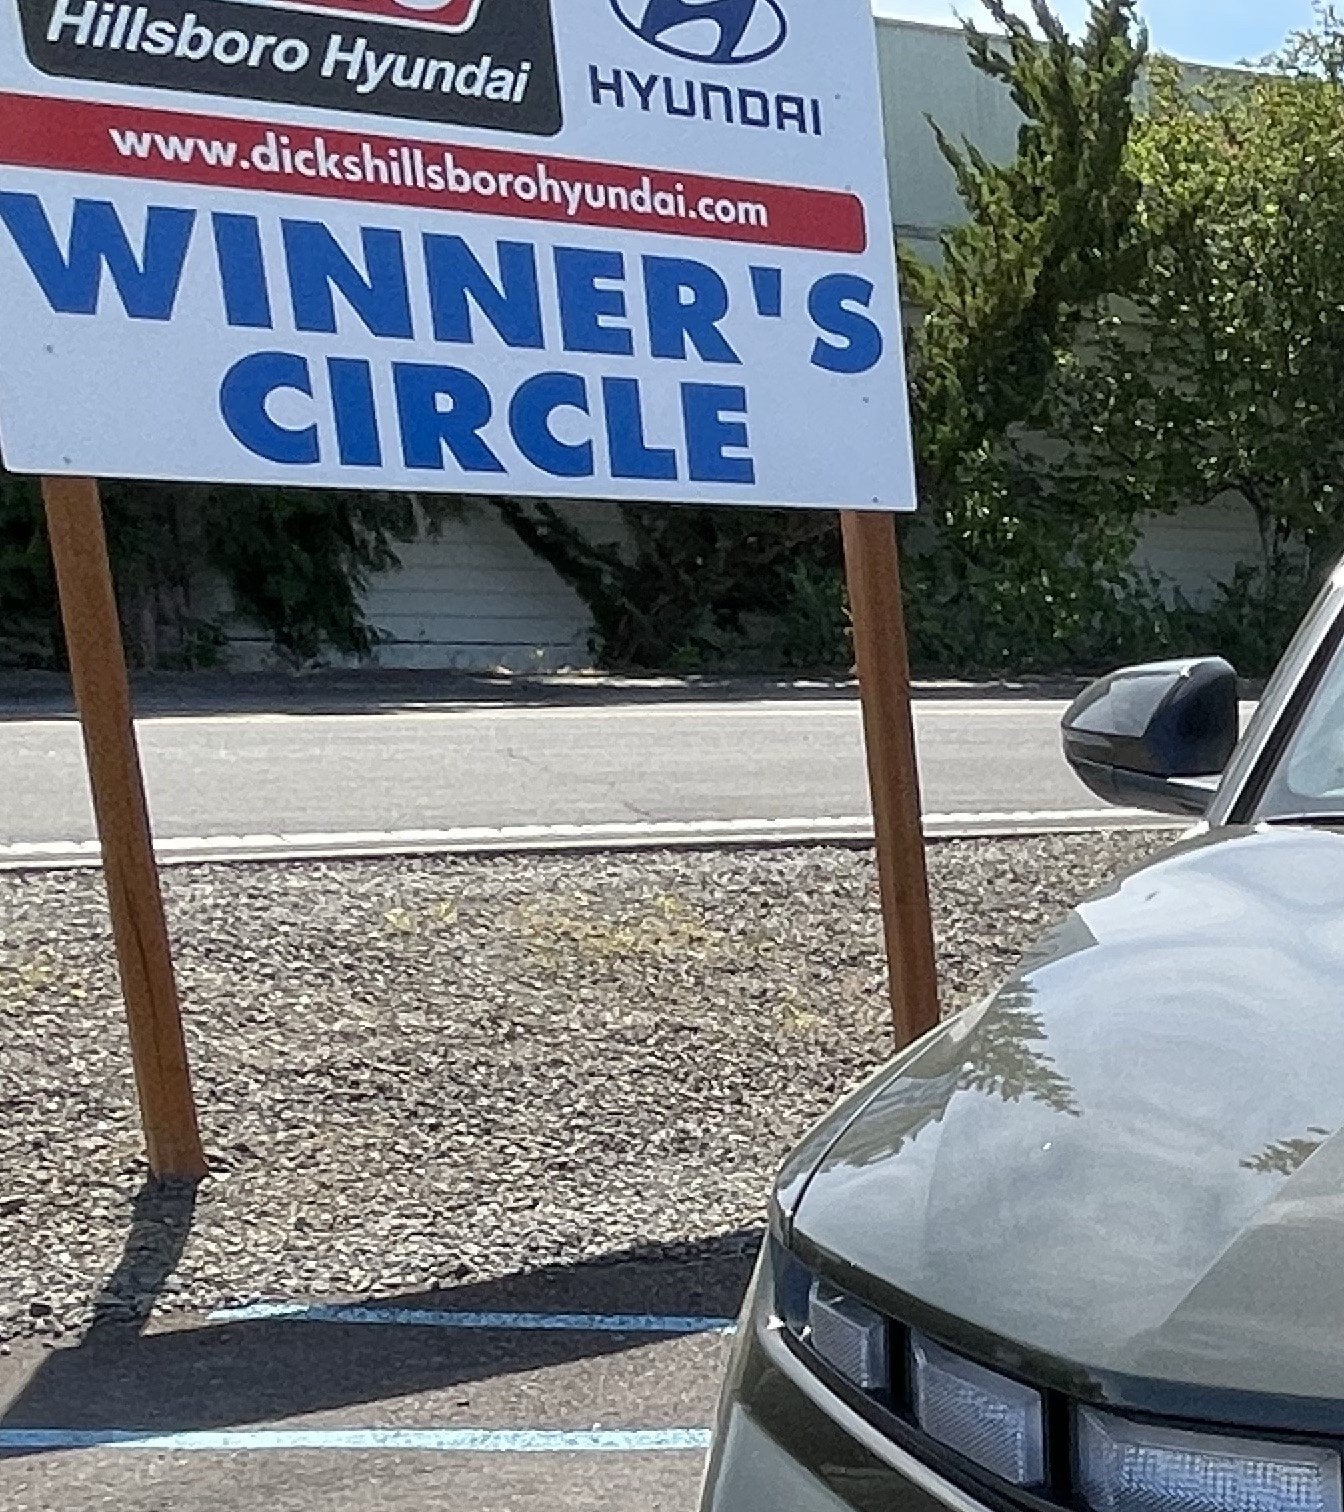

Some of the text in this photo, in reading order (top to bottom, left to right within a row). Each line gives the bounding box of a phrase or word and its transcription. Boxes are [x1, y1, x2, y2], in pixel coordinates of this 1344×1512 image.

[46, 0, 532, 102] Hillsboro Hyundai
[588, 64, 822, 136] HYUNDAI
[109, 124, 768, 228] www.dickshillsborohyundai.com
[0, 191, 884, 374] WINNER'S
[219, 350, 756, 485] CIRCLE
